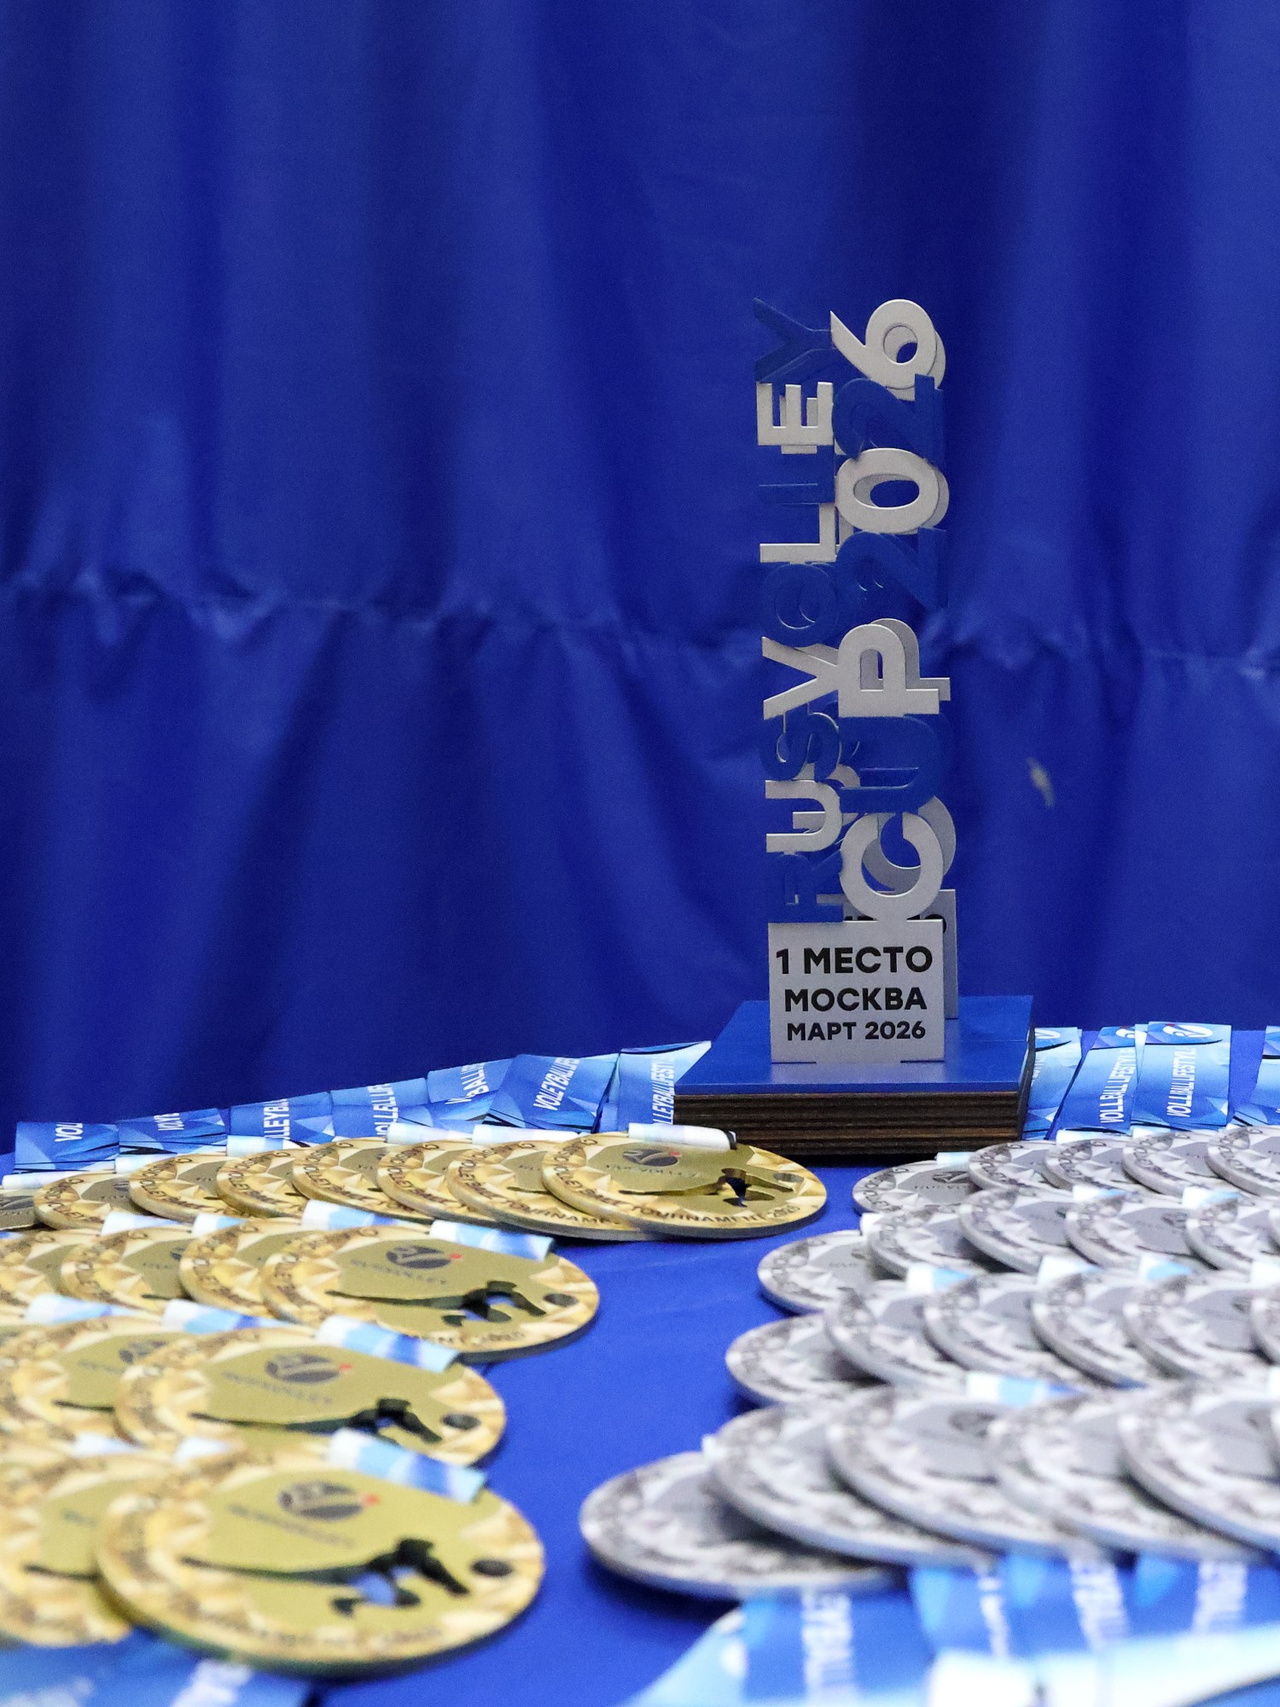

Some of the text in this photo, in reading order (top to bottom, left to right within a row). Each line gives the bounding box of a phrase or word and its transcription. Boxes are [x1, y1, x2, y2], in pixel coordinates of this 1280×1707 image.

[836, 623, 943, 918] CUP
[775, 945, 933, 975] 1 МЕСТО
[783, 986, 928, 1013] МОСКВА
[786, 1019, 927, 1042] МАРТ 2026
